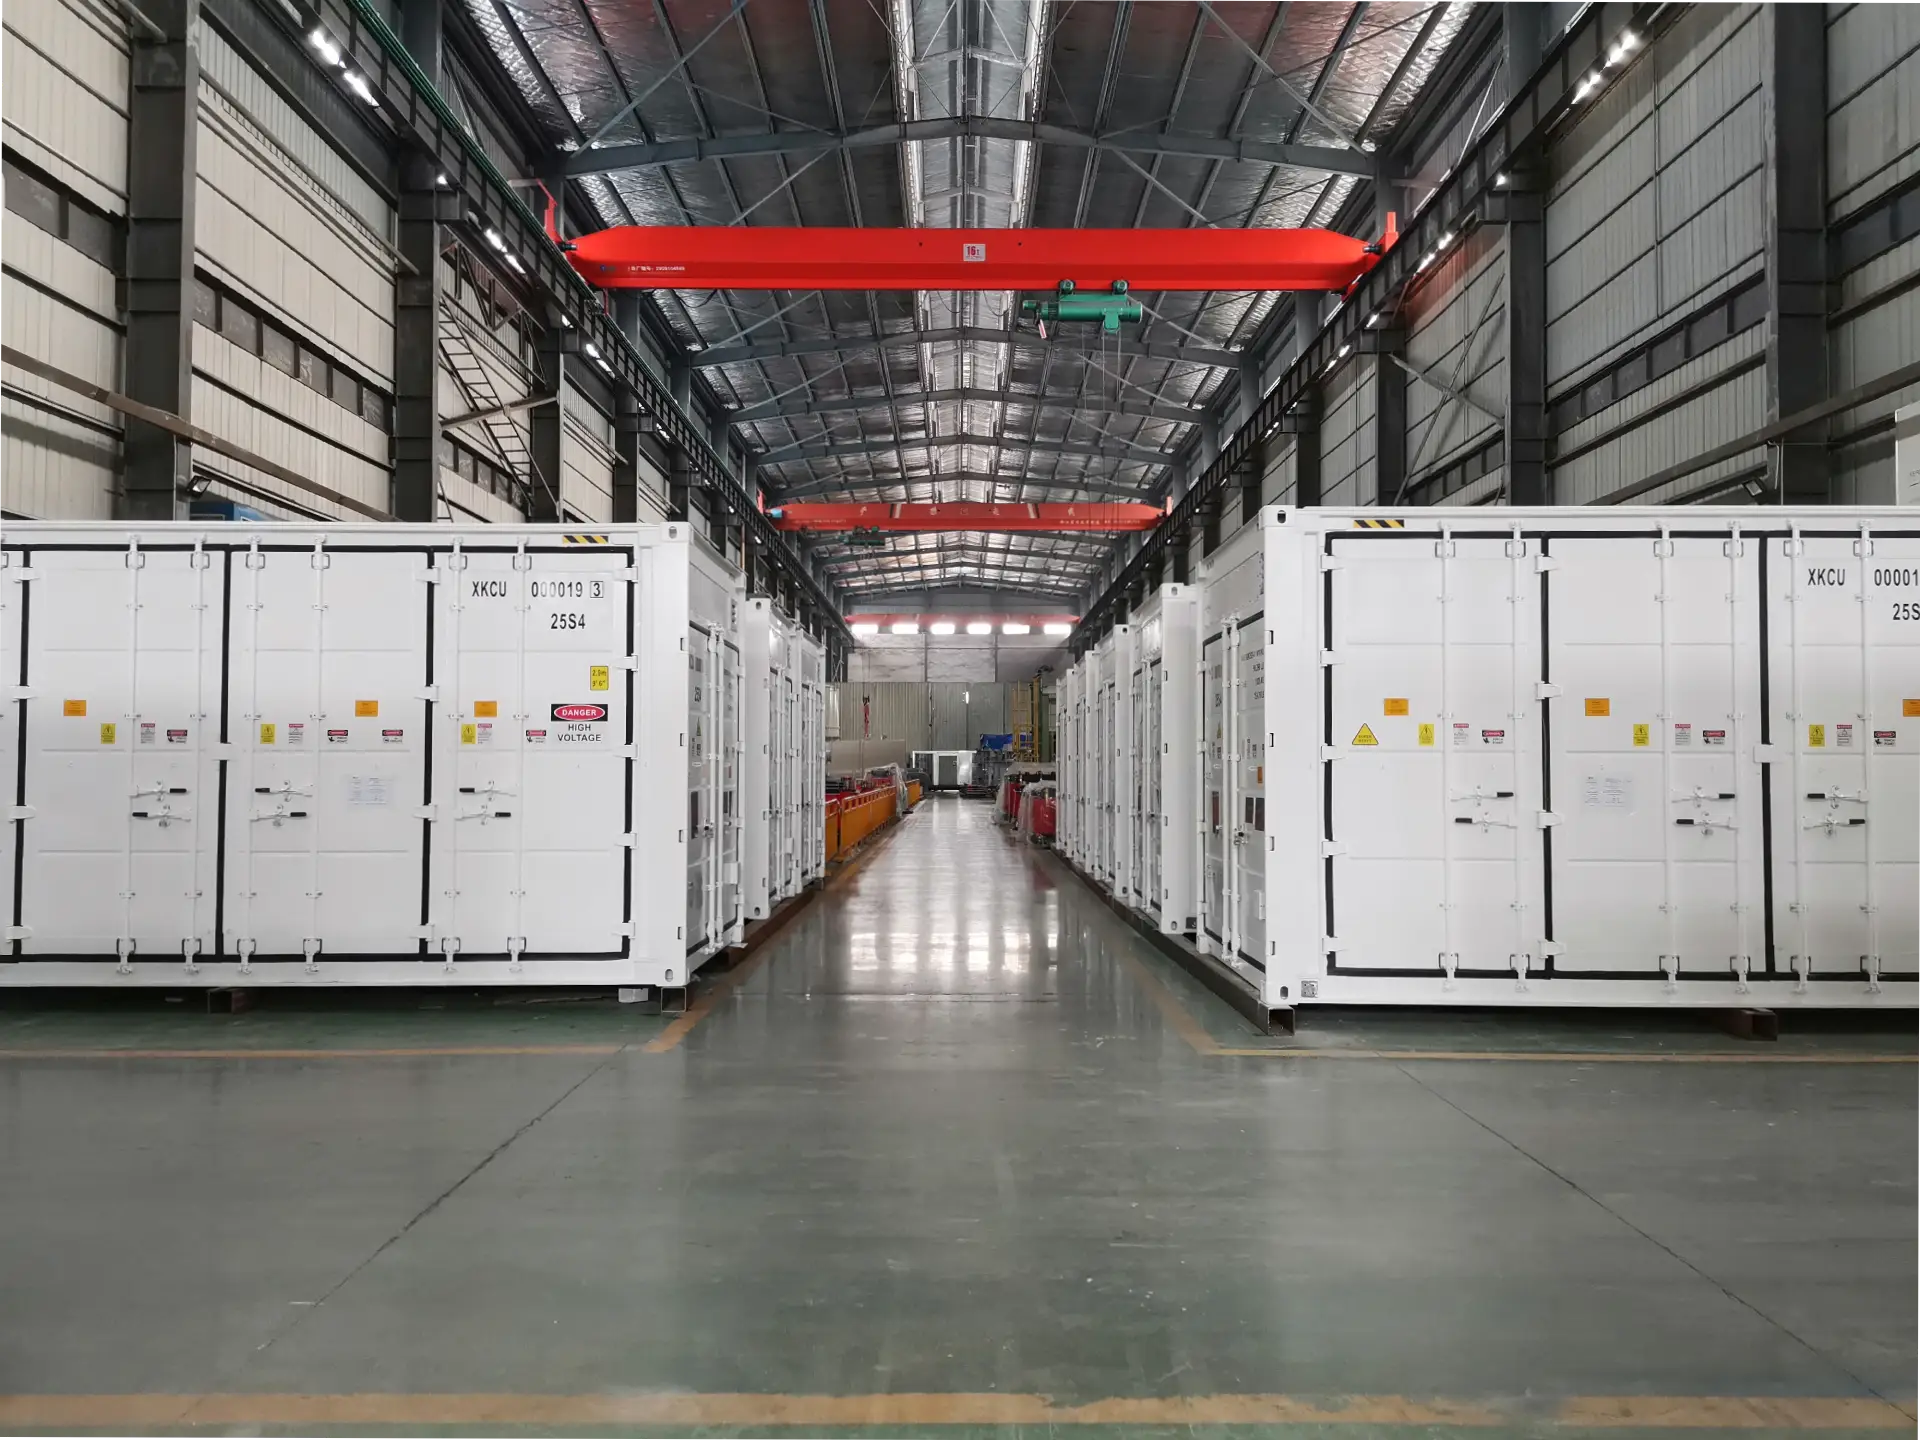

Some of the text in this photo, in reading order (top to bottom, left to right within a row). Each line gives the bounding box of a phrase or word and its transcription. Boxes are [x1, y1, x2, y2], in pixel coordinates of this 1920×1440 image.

[1807, 568, 1919, 586] XKCU 00001
[472, 581, 602, 598] XKCU 000019 3
[550, 613, 586, 630] 25S4
[562, 709, 597, 717] DANGER
[568, 723, 592, 732] HIGH
[557, 733, 602, 742] VOLTAGE
